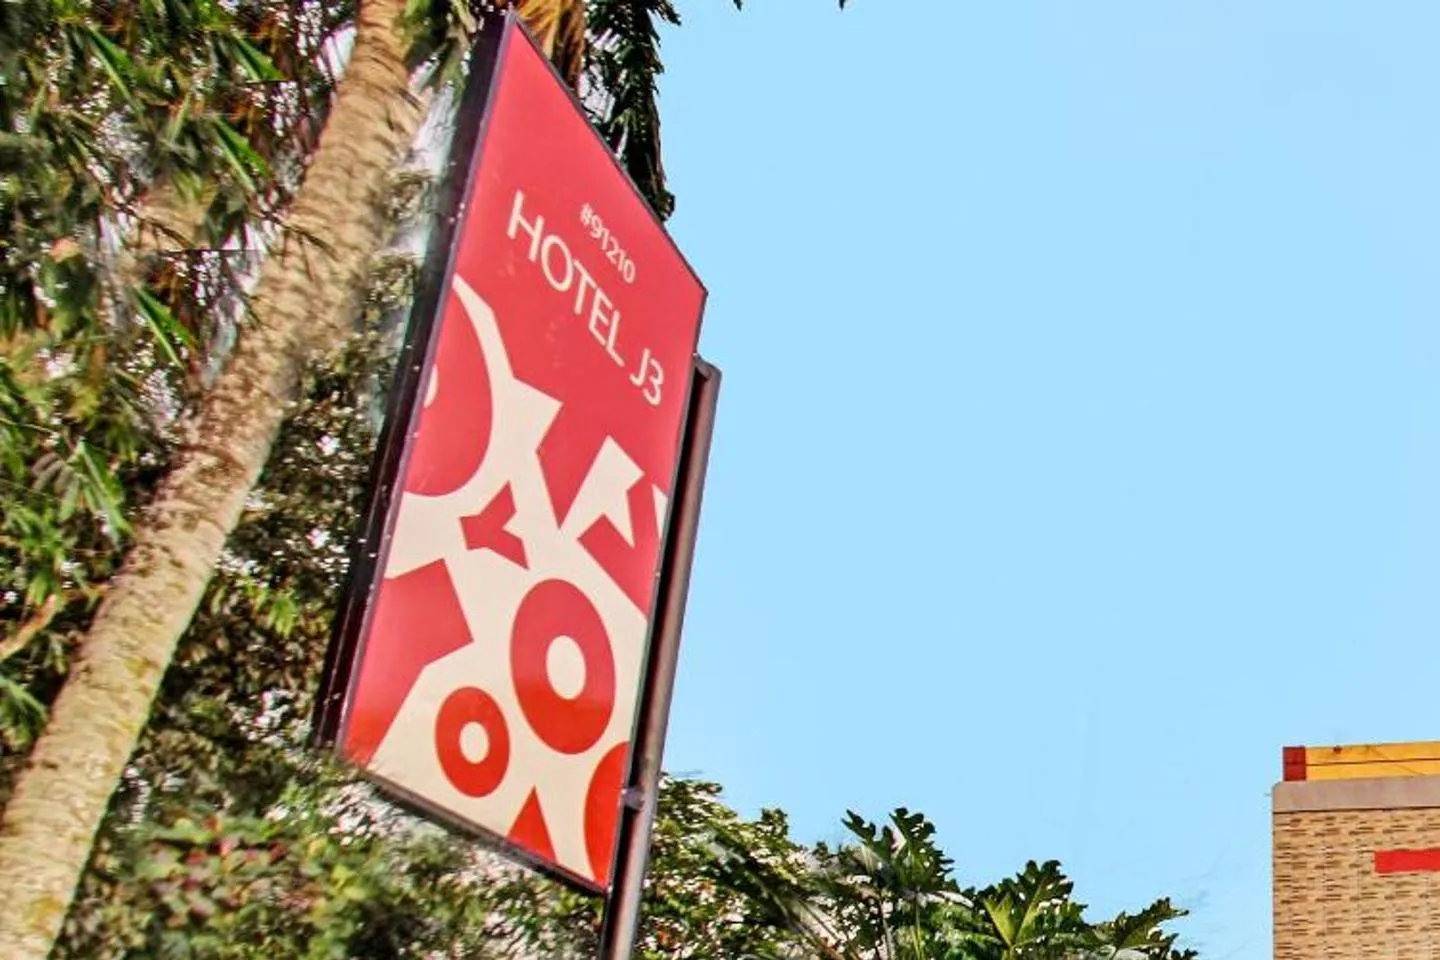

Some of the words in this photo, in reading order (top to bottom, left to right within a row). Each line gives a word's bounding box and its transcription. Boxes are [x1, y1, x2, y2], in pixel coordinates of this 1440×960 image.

[506, 190, 626, 368] HOTEL
[628, 347, 665, 407] J3
[579, 202, 637, 284] #91210
